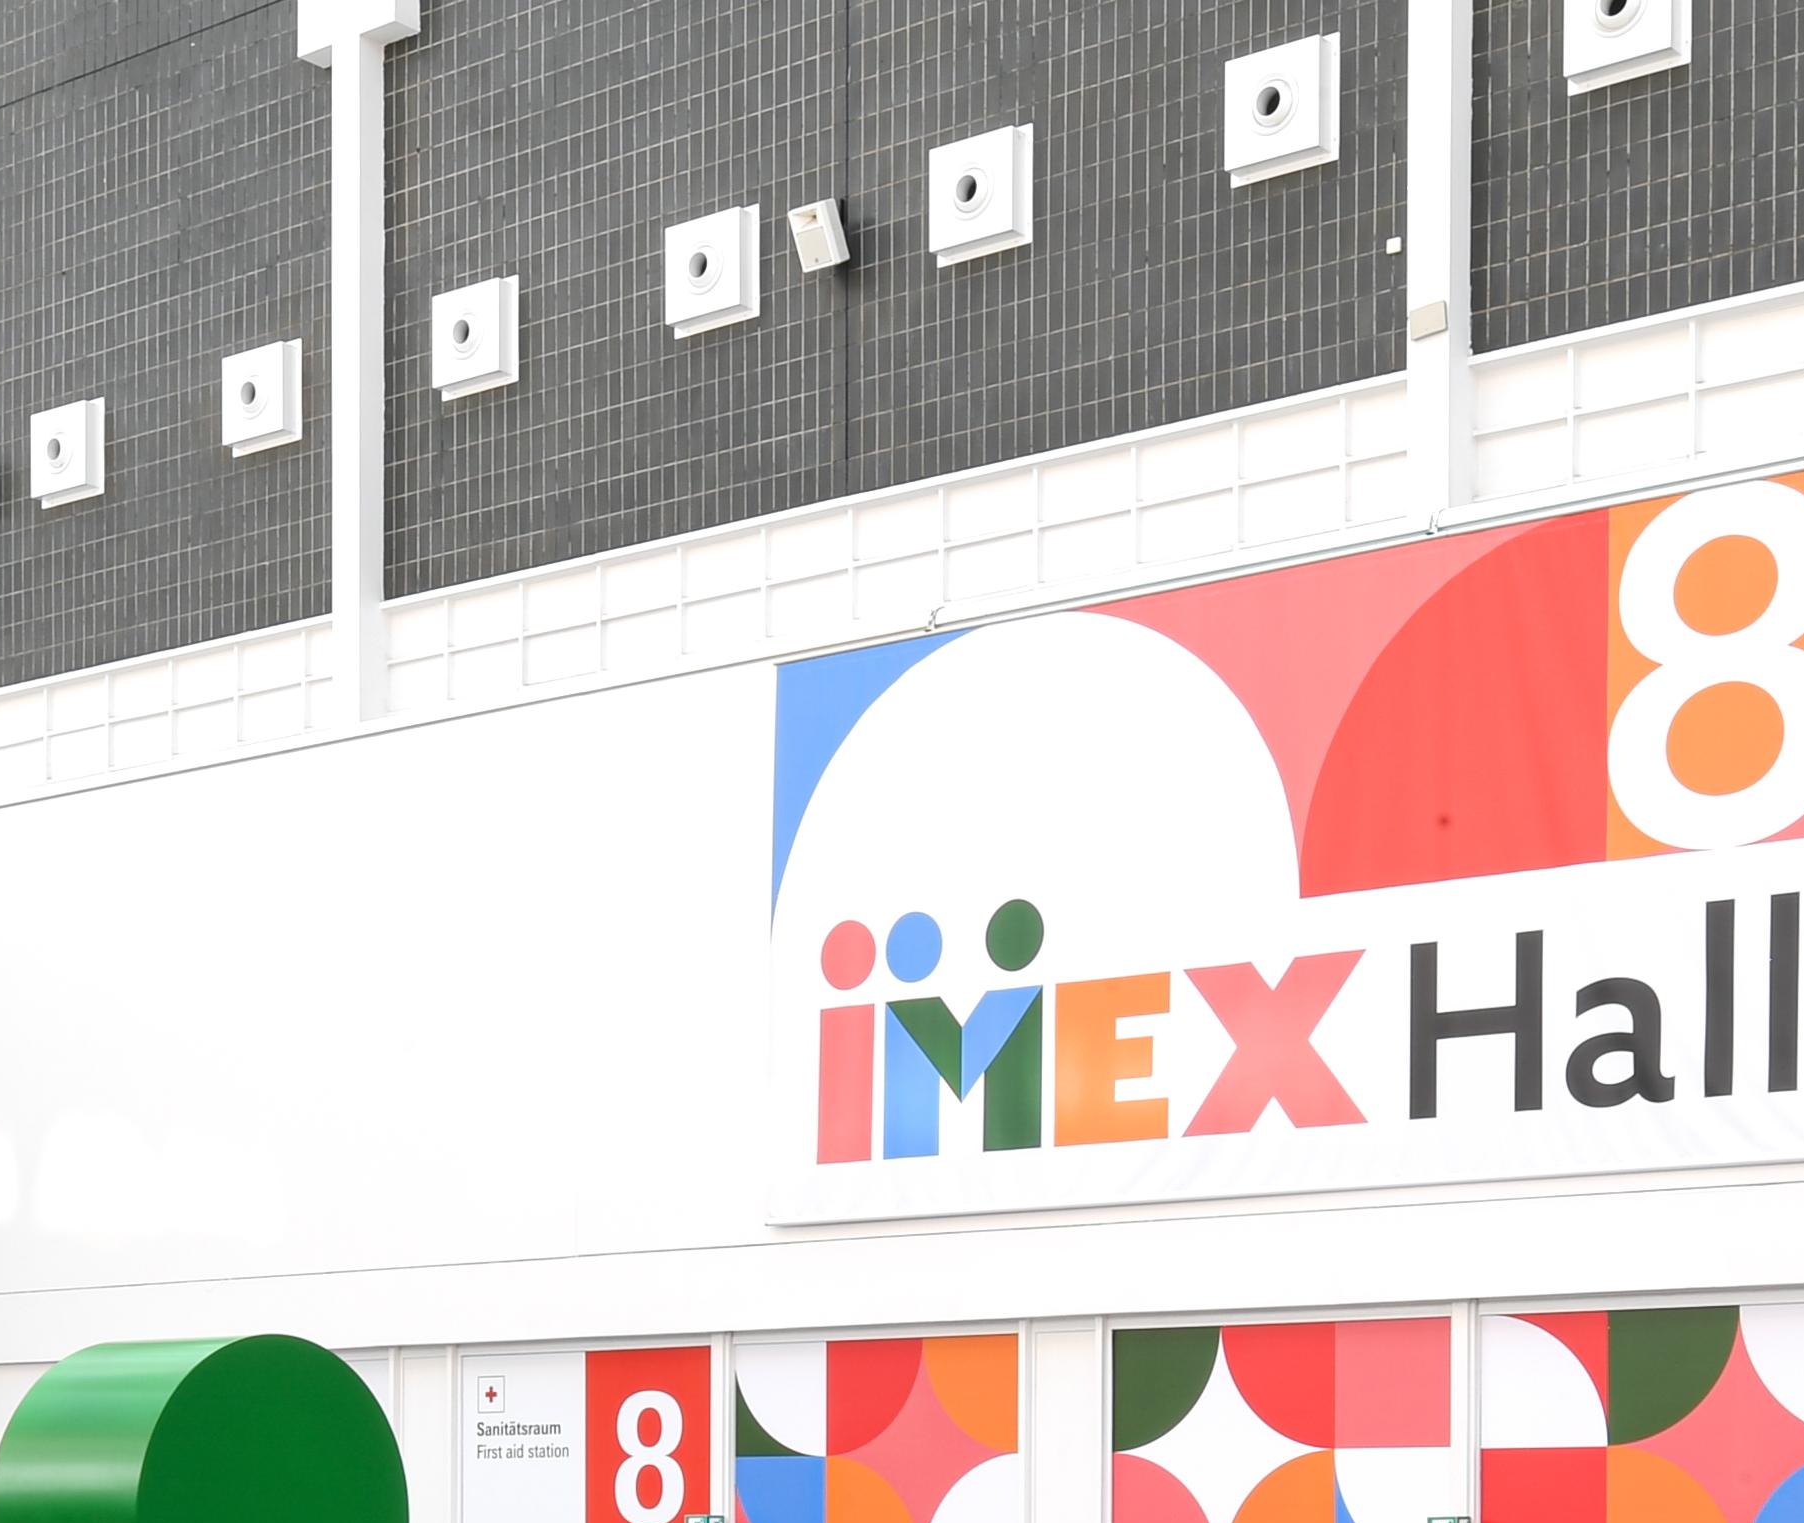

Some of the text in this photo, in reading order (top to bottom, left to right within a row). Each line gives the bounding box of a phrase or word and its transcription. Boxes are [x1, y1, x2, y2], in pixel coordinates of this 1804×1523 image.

[1407, 893, 1801, 1122] Hall
[476, 1420, 562, 1437] Sanitätsraum
[476, 1442, 570, 1460] First aid station
